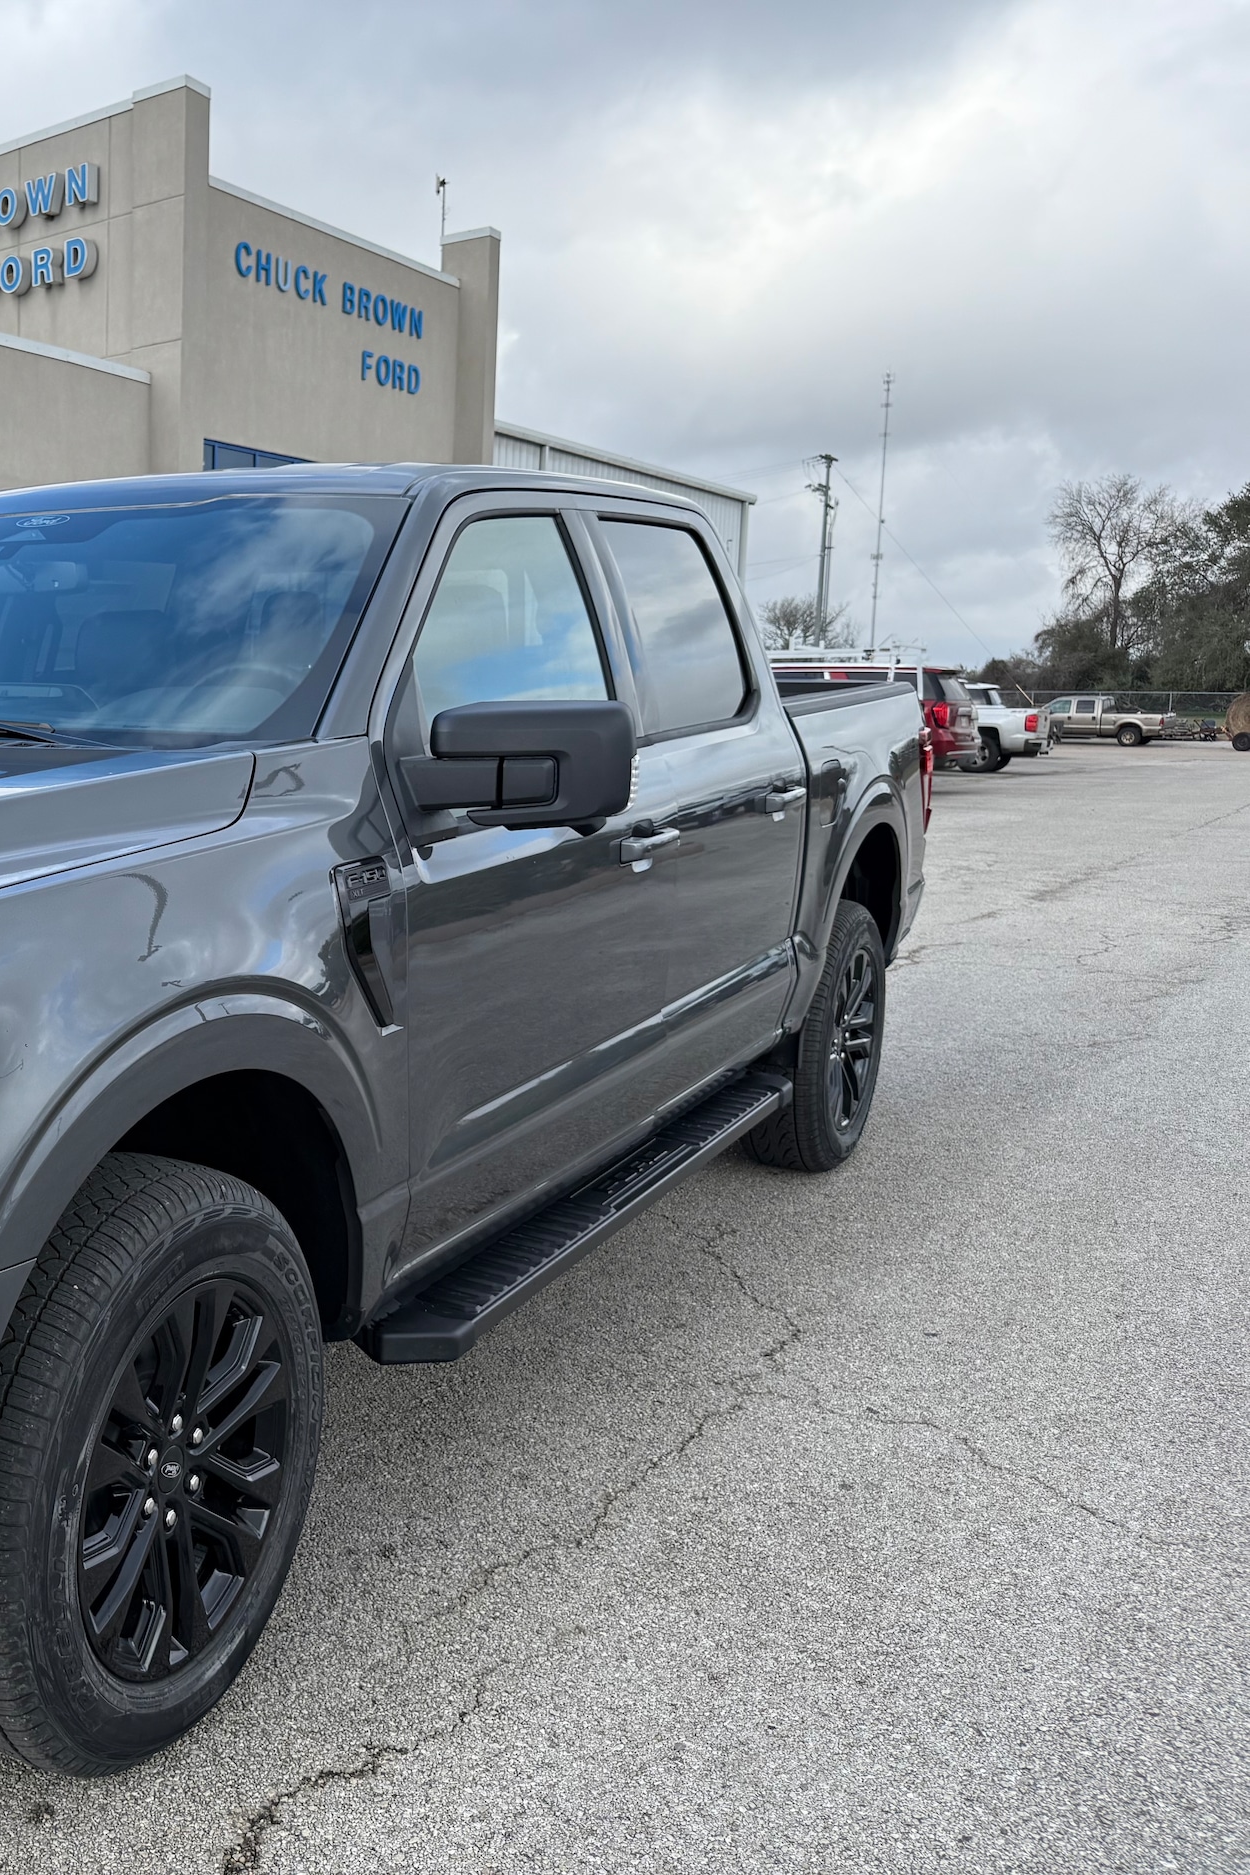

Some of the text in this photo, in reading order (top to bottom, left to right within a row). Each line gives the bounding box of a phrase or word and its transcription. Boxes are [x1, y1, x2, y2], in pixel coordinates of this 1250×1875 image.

[235, 241, 424, 340] CHUCK BROWN
[361, 350, 421, 395] FORD
[273, 1250, 321, 1424] SCORPION
